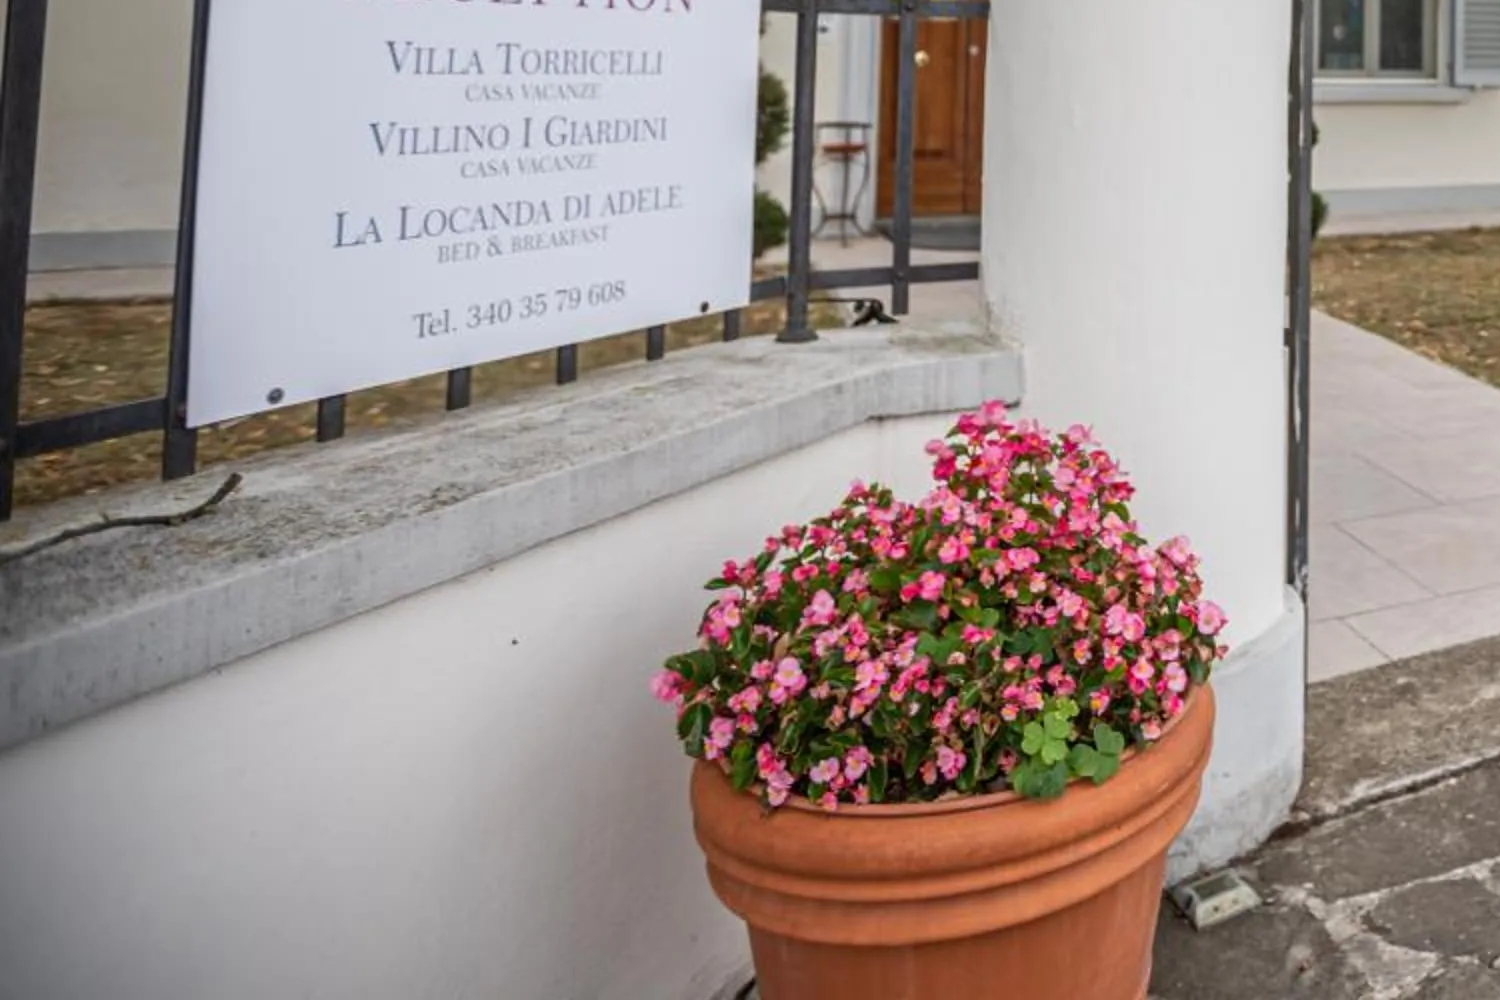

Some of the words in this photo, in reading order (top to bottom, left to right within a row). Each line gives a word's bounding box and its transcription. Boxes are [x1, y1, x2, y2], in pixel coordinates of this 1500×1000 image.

[385, 41, 484, 75] VILLA
[496, 43, 663, 76] TORRICELLI
[465, 84, 513, 102] CASA
[520, 83, 602, 101] VACANZE
[369, 121, 509, 156] VILLINO
[522, 117, 533, 149] I
[545, 115, 667, 148] GIARDINI
[460, 160, 509, 179] CASA
[518, 153, 598, 174] VACANZE
[333, 211, 382, 248] LA
[399, 199, 552, 241] LOCANDA
[563, 194, 591, 221] DI
[600, 184, 682, 217] ADELE
[438, 244, 480, 264] BED
[486, 235, 503, 257] &
[511, 226, 609, 254] BREAKFAST
[413, 311, 457, 339] Tel.
[466, 304, 512, 331] 340
[519, 293, 547, 319] 35
[555, 287, 582, 313] 79
[588, 280, 626, 306] 608
